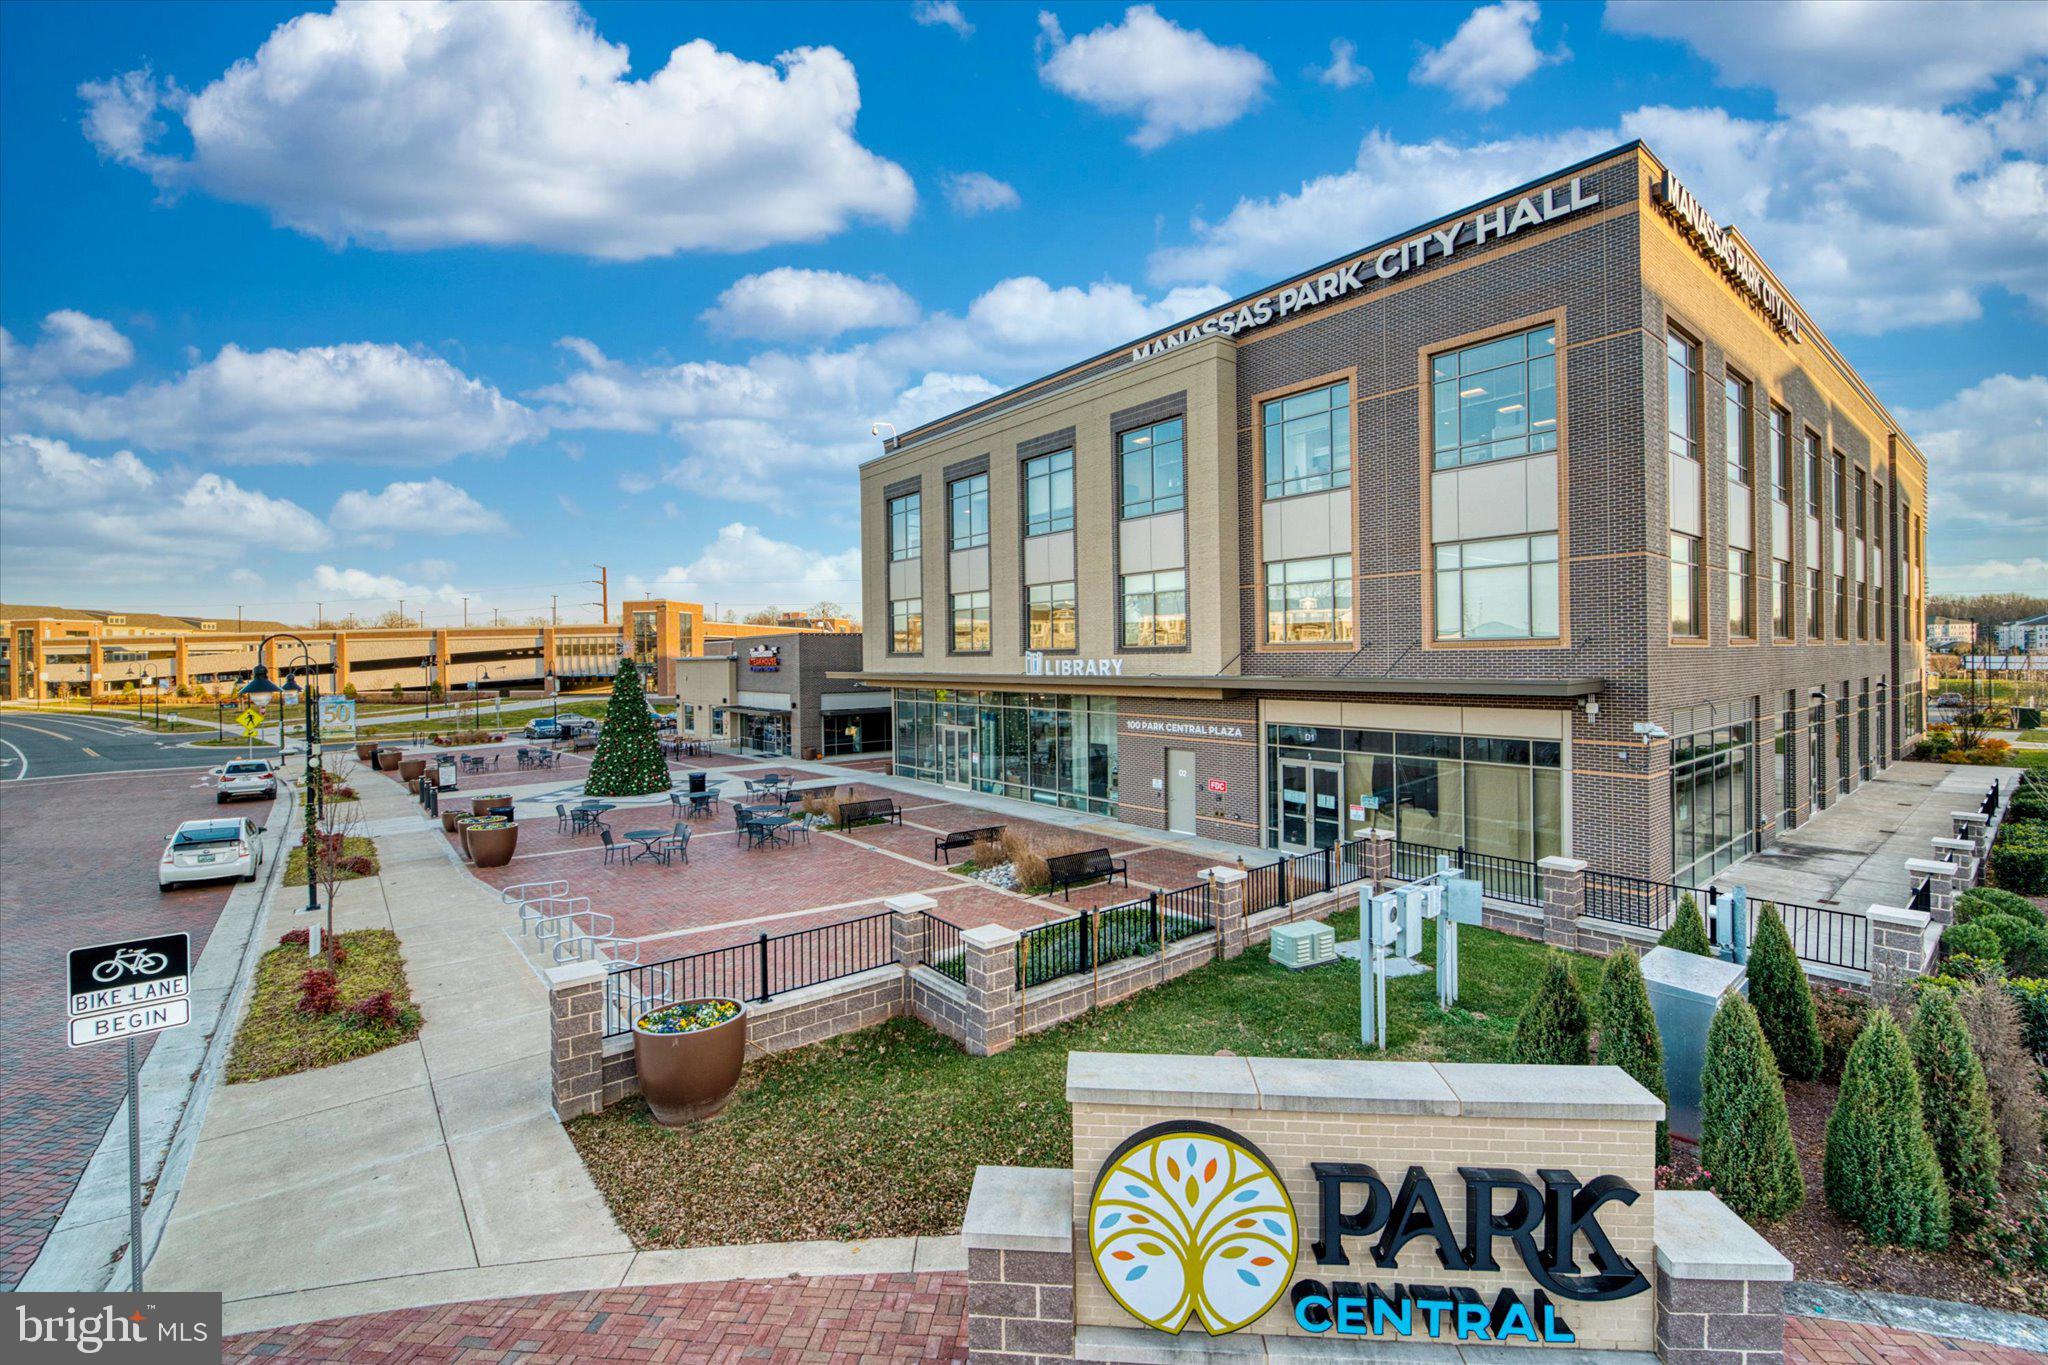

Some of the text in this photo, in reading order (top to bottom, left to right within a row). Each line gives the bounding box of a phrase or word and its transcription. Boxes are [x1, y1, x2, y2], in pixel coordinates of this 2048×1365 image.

[1279, 260, 1364, 318] PARK
[1375, 221, 1464, 279] CITY
[1476, 177, 1600, 245] HALL
[1667, 169, 1803, 344] MANASSAS PARK CITY HALL
[1045, 658, 1124, 676] LIBRARY
[324, 704, 351, 723] 50
[1126, 720, 1243, 738] 100 PARK CENTRAL PLAZA
[1210, 781, 1225, 791] FDC
[76, 978, 184, 1012] BIKE LANE
[95, 1008, 167, 1036] BEGIN
[1311, 1161, 1652, 1302] PARK
[1292, 1288, 1577, 1344] CENTRAL
